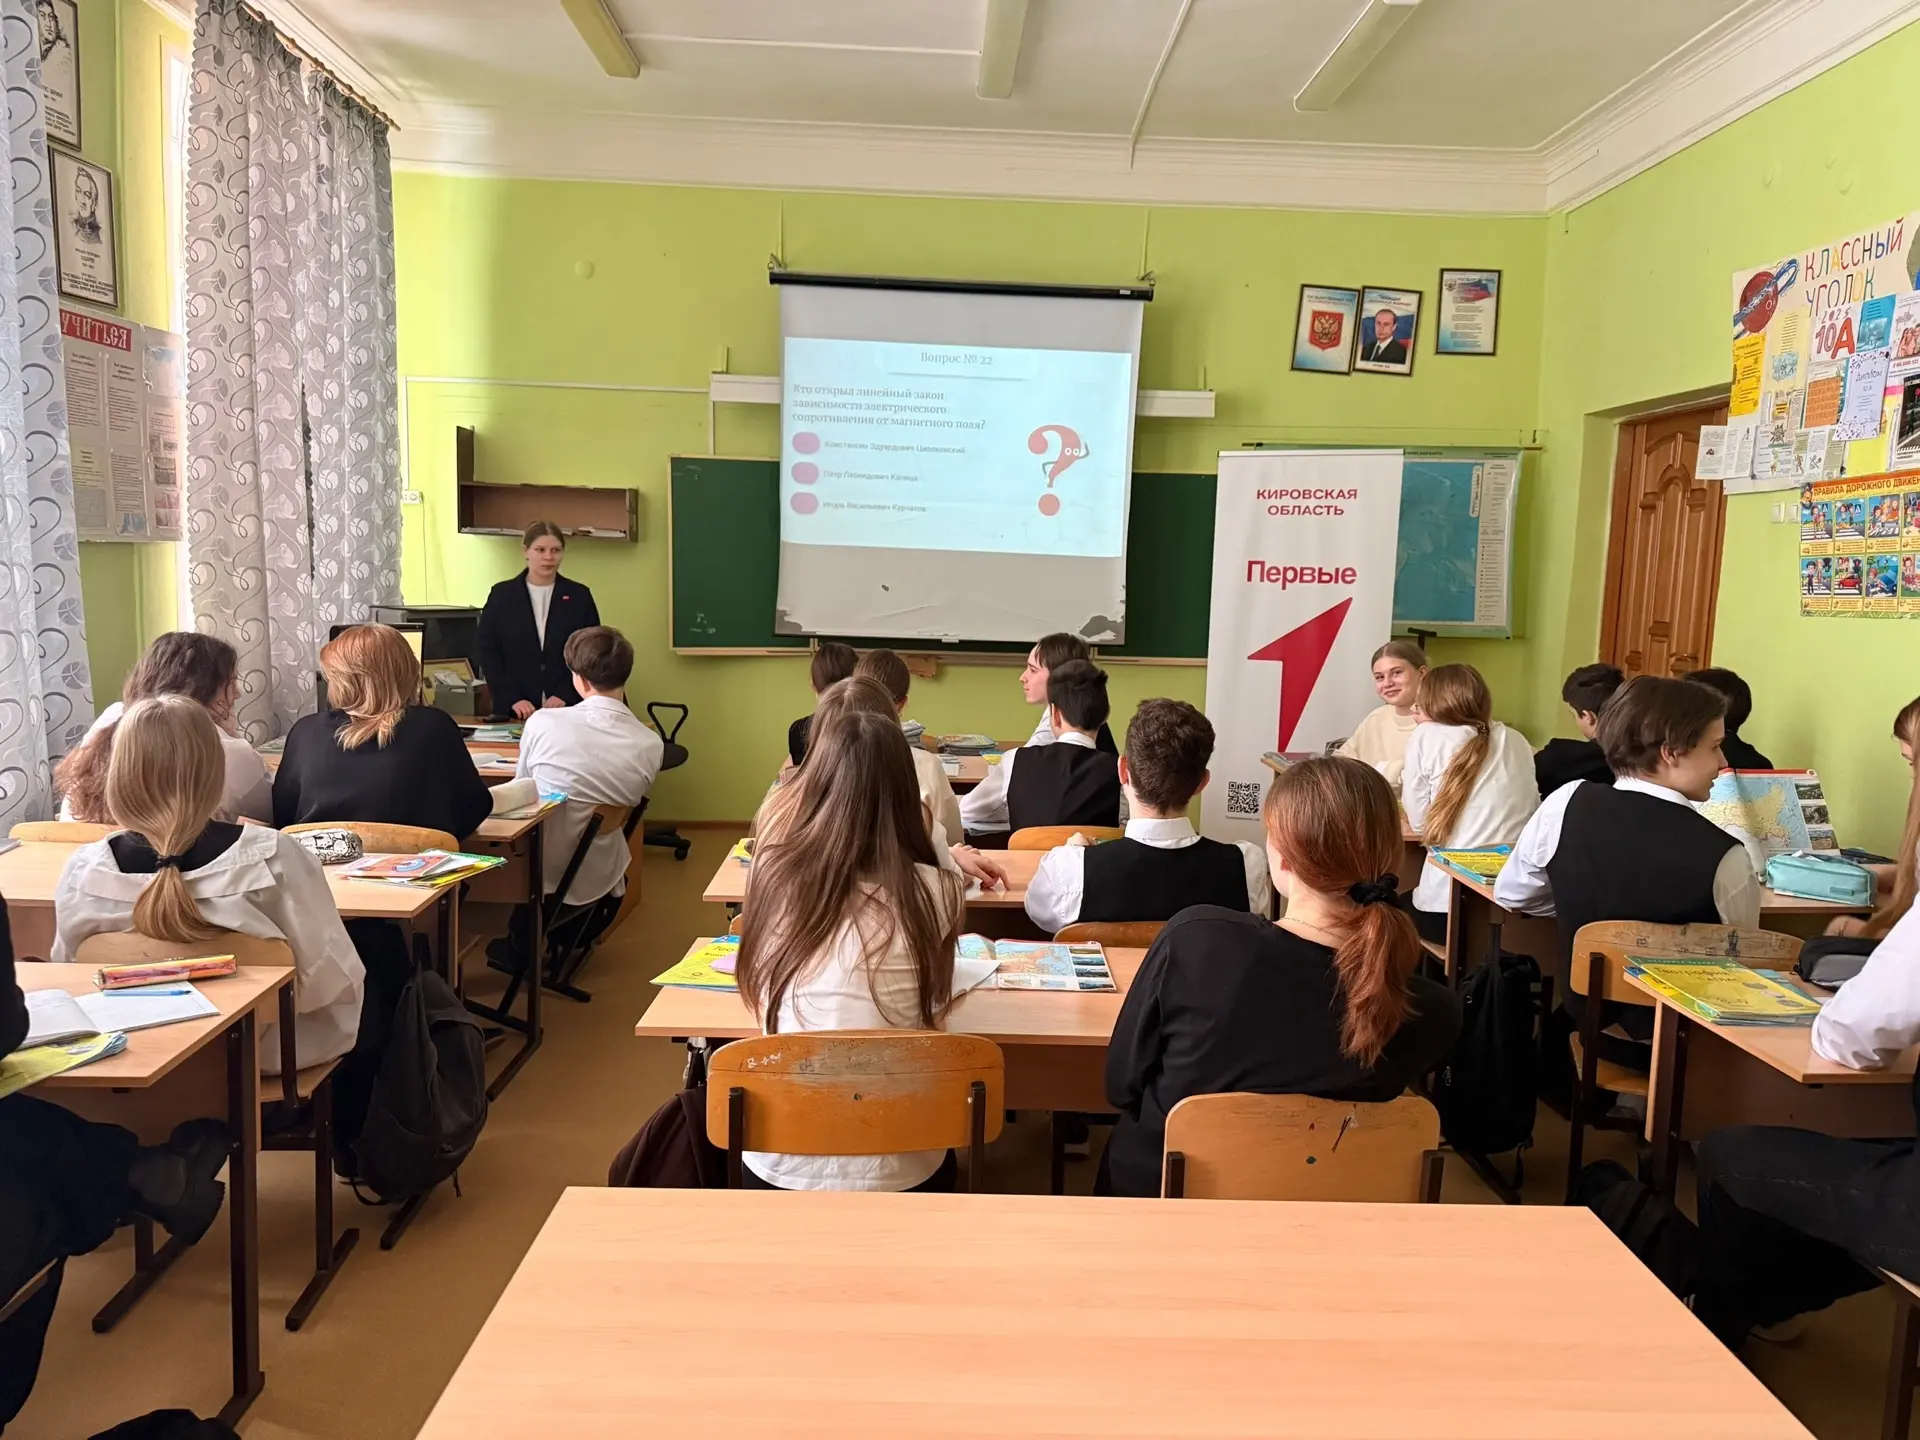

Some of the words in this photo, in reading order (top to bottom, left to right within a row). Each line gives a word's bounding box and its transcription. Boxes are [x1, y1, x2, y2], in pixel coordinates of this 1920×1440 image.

[1804, 217, 1904, 282] КЛАССНЫЙ
[1806, 266, 1875, 317] УГОЛОК
[61, 312, 128, 349] УЧИТЬСЯ
[1815, 317, 1856, 360] 10А
[921, 352, 961, 365] Вопрос
[963, 353, 977, 364] №
[980, 356, 993, 365] 22
[793, 384, 813, 394] Кто
[814, 386, 854, 397] открыл
[856, 387, 912, 399] линейный
[914, 392, 944, 400] закон
[792, 400, 862, 410] зависимости
[864, 402, 947, 414] электрического
[792, 413, 874, 424] сопротивления
[876, 417, 888, 425] от
[890, 417, 953, 428] магнитного
[955, 419, 986, 430] поля?
[1256, 489, 1358, 500] КИРОВСКАЯ
[1813, 486, 1844, 497] ПРАВИЛА
[1846, 480, 1891, 494] ДОРОЖНОГО
[1267, 505, 1345, 516] ОБЛАСТЬ
[1247, 560, 1357, 590] Первые
